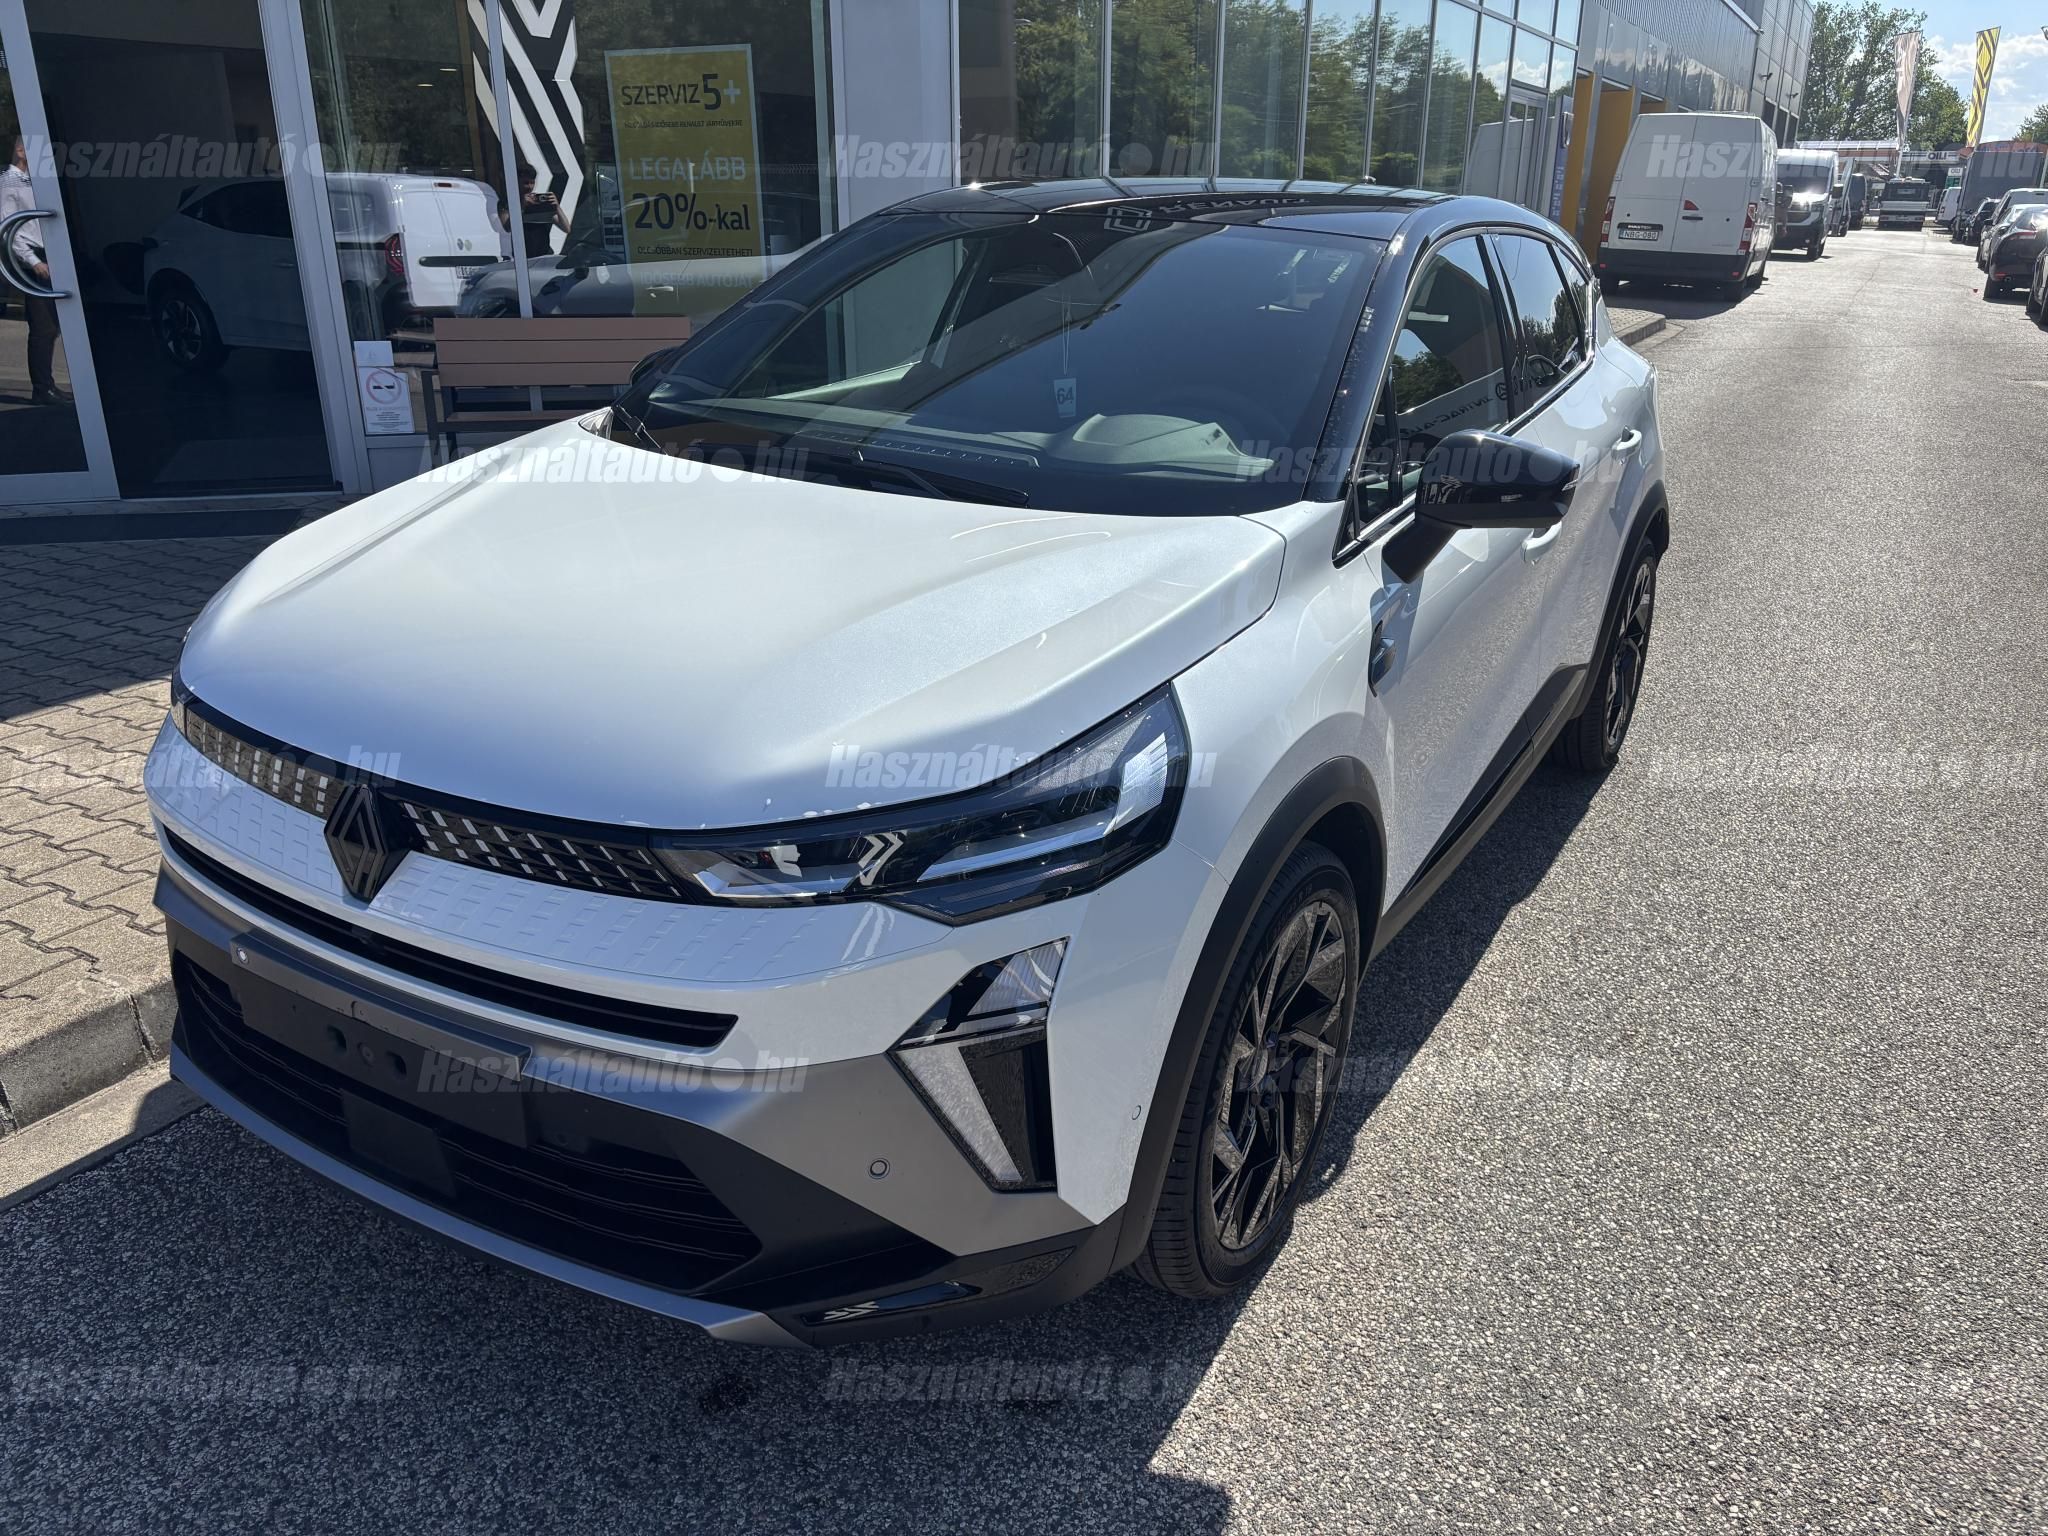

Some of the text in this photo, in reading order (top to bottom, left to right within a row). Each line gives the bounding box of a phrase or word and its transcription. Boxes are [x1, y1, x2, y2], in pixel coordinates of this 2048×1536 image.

[621, 83, 701, 106] SZERVIZ
[629, 147, 747, 182] LEGALÁBB
[632, 192, 751, 231] 20%-kal
[1057, 387, 1074, 404] 64
